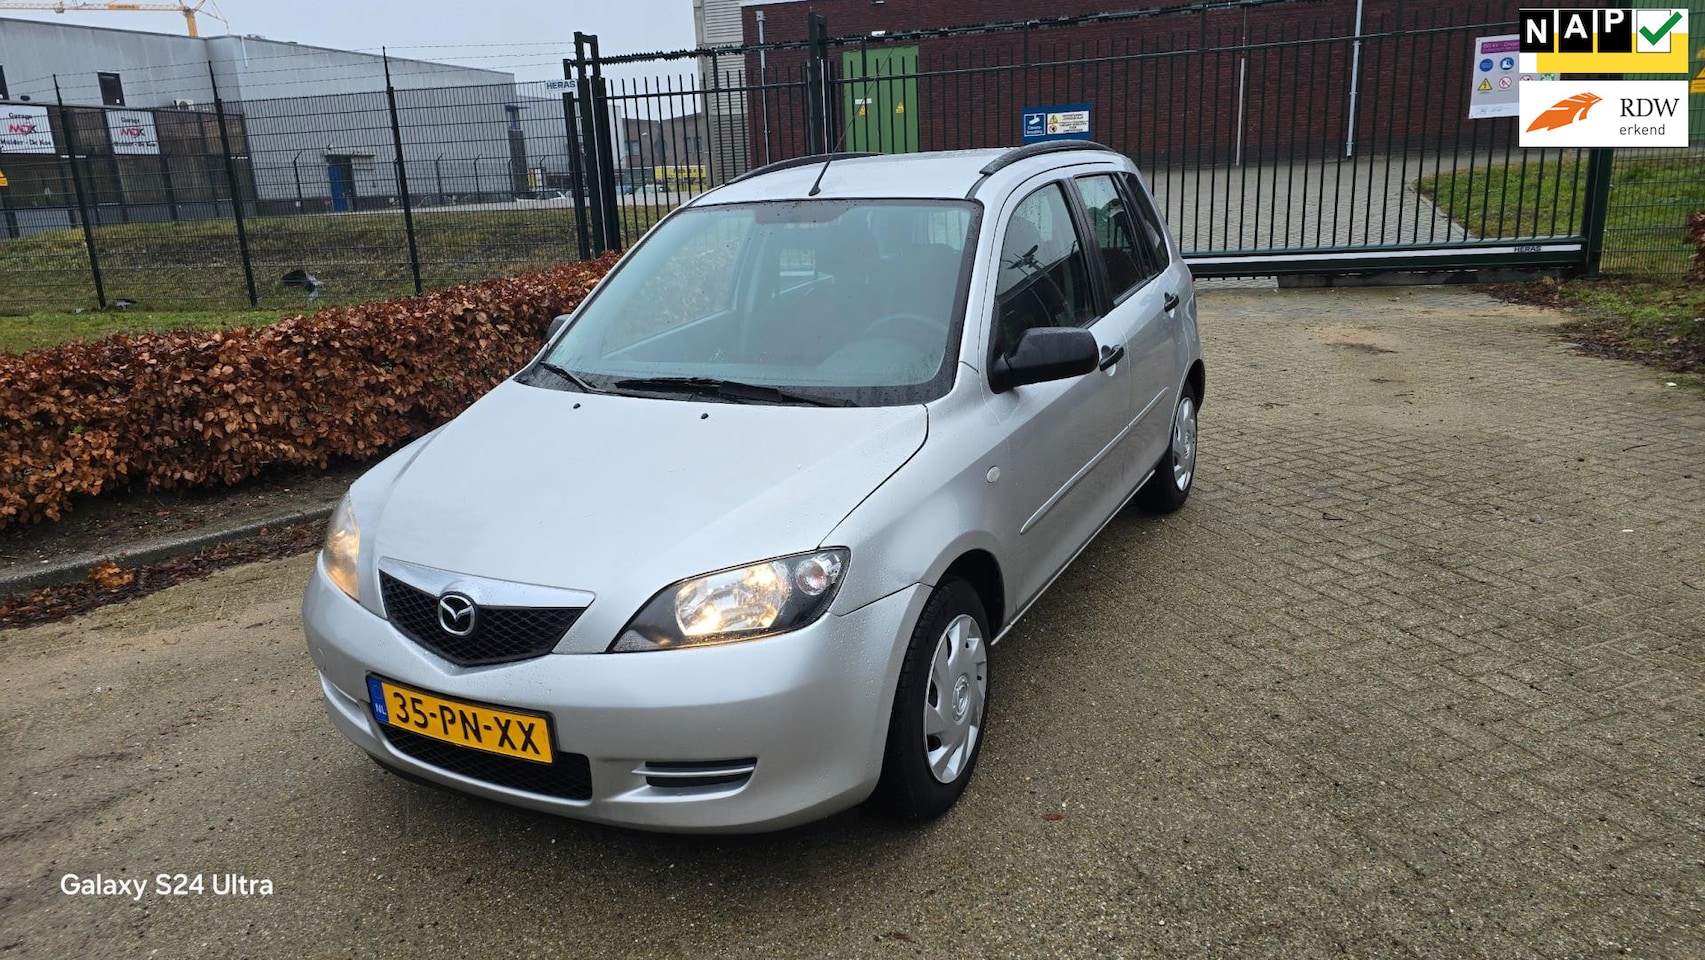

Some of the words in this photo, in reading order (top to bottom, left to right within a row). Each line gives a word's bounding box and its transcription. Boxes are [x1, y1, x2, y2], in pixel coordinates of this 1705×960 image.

[546, 80, 576, 90] HERAS
[375, 703, 387, 715] NL
[393, 692, 540, 755] 35-PN-XX
